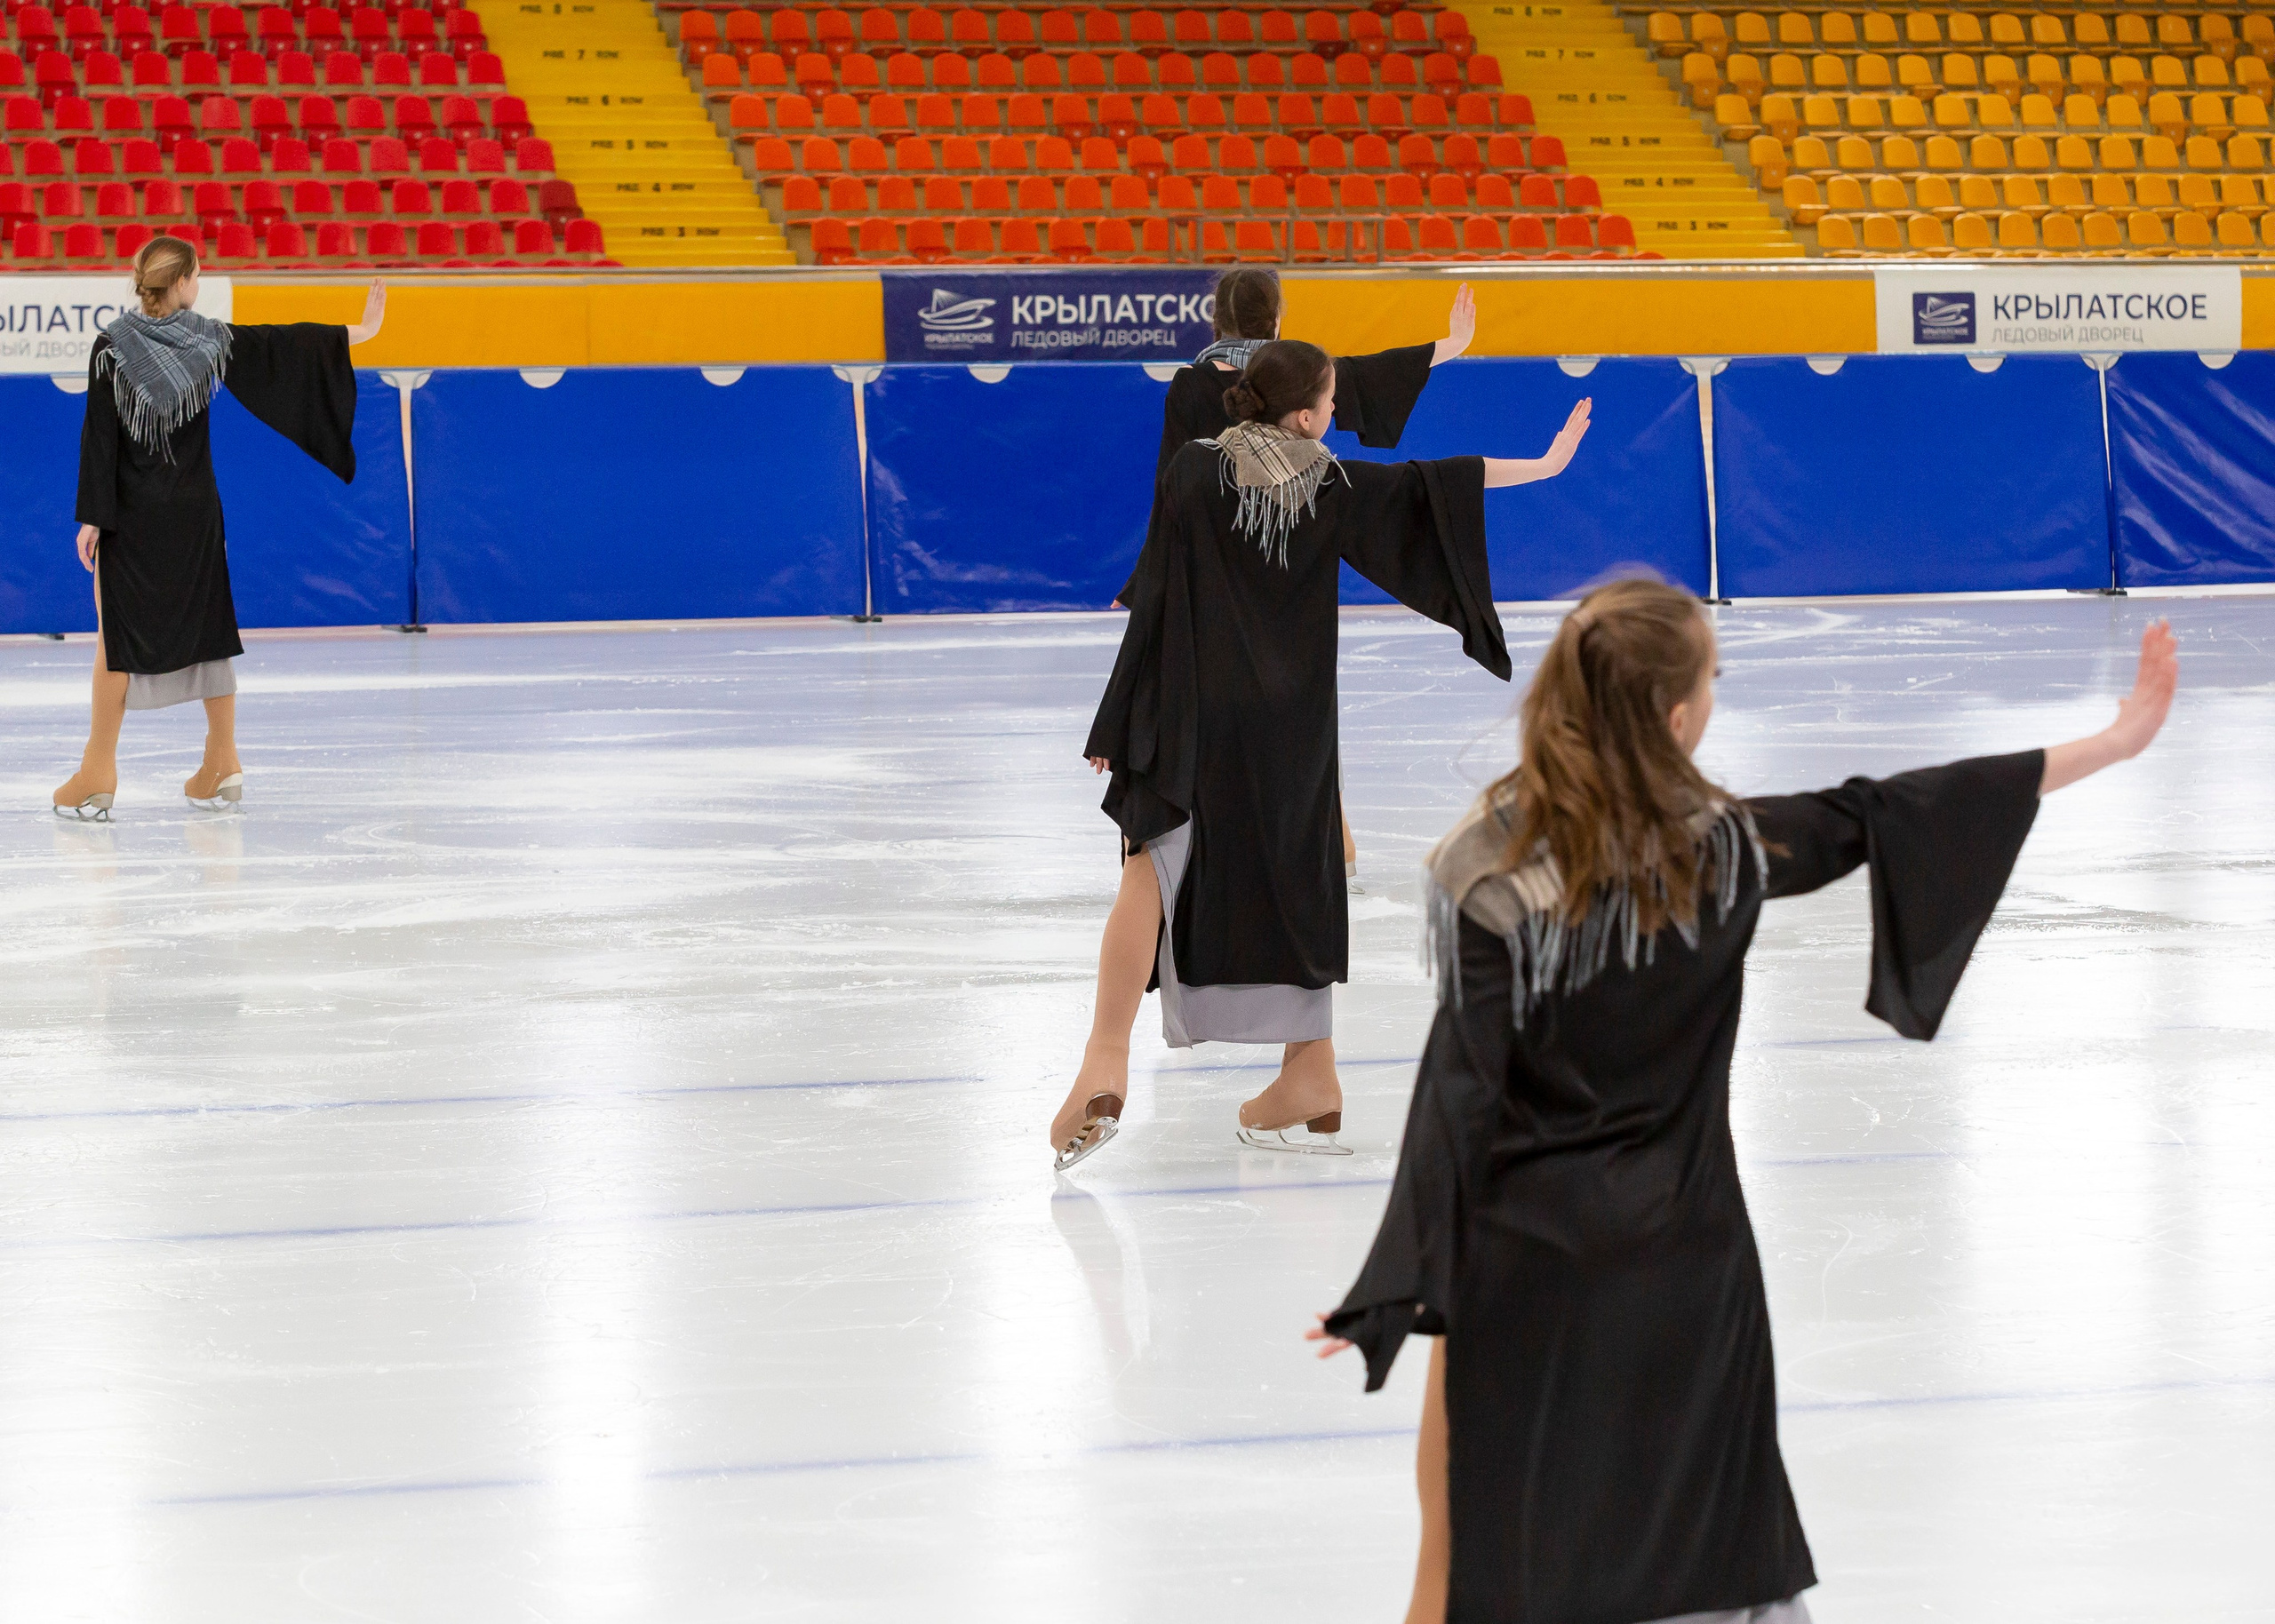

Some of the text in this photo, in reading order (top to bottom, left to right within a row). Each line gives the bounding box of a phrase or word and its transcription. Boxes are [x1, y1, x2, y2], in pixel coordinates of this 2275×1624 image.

[579, 49, 585, 60] 7
[1559, 49, 1564, 60] 7
[652, 183, 660, 192] 4
[1656, 178, 1664, 187] 4
[1993, 293, 2207, 321] КРЫЛАТСКОЕ
[0, 305, 139, 333] ЫЛАТС
[1011, 326, 1177, 349] ЛЕДОВЫЙ ДВОРЕЦ
[1992, 325, 2144, 345] ЛЕДОВЫЙ ДВОРЕЦ
